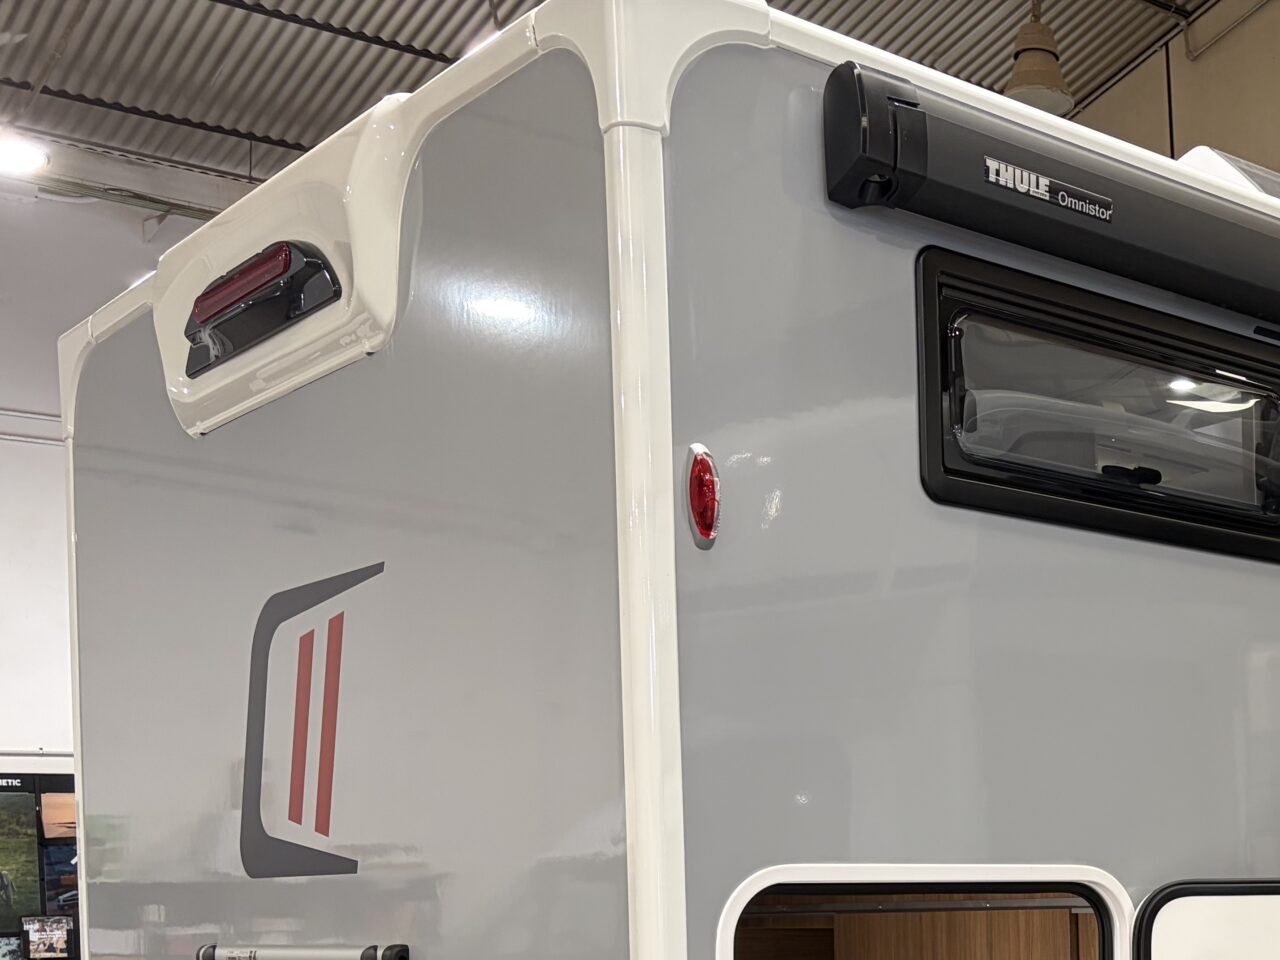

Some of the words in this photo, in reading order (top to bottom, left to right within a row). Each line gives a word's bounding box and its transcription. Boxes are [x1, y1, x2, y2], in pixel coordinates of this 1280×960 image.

[985, 158, 1050, 197] THULE
[1058, 191, 1112, 220] Omnistor
[0, 778, 22, 787] ETIC
